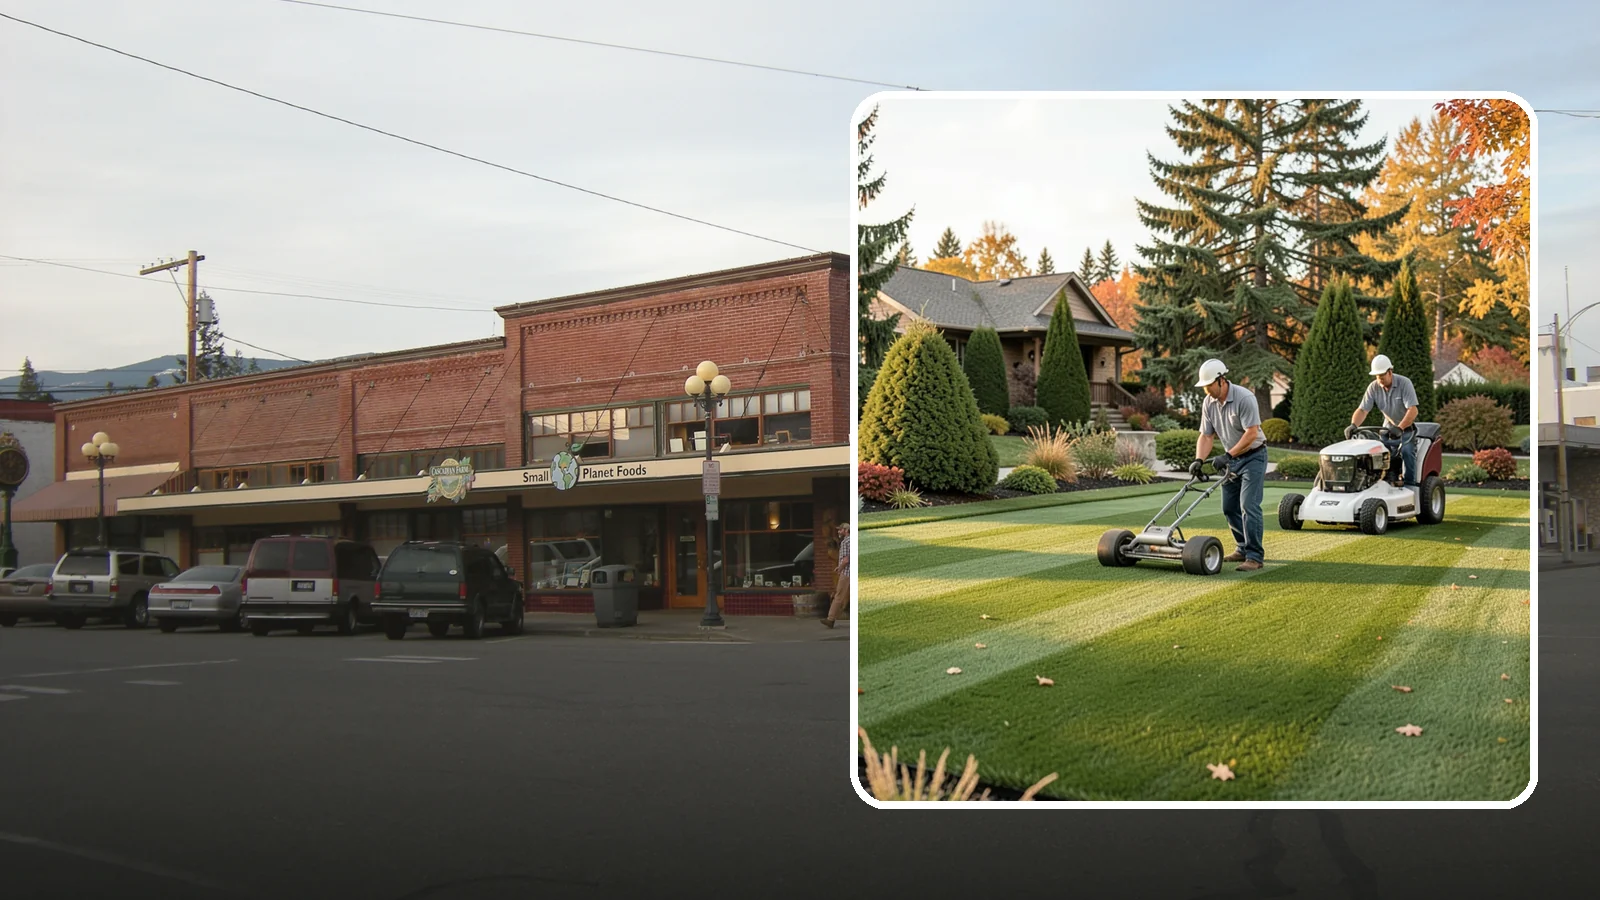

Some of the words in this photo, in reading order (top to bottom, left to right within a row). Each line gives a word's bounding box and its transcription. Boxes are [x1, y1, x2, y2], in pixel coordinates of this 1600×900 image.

[432, 467, 455, 475] CASCADIAN
[523, 471, 549, 483] Small
[583, 467, 614, 479] Planet
[617, 464, 647, 477] Foods
